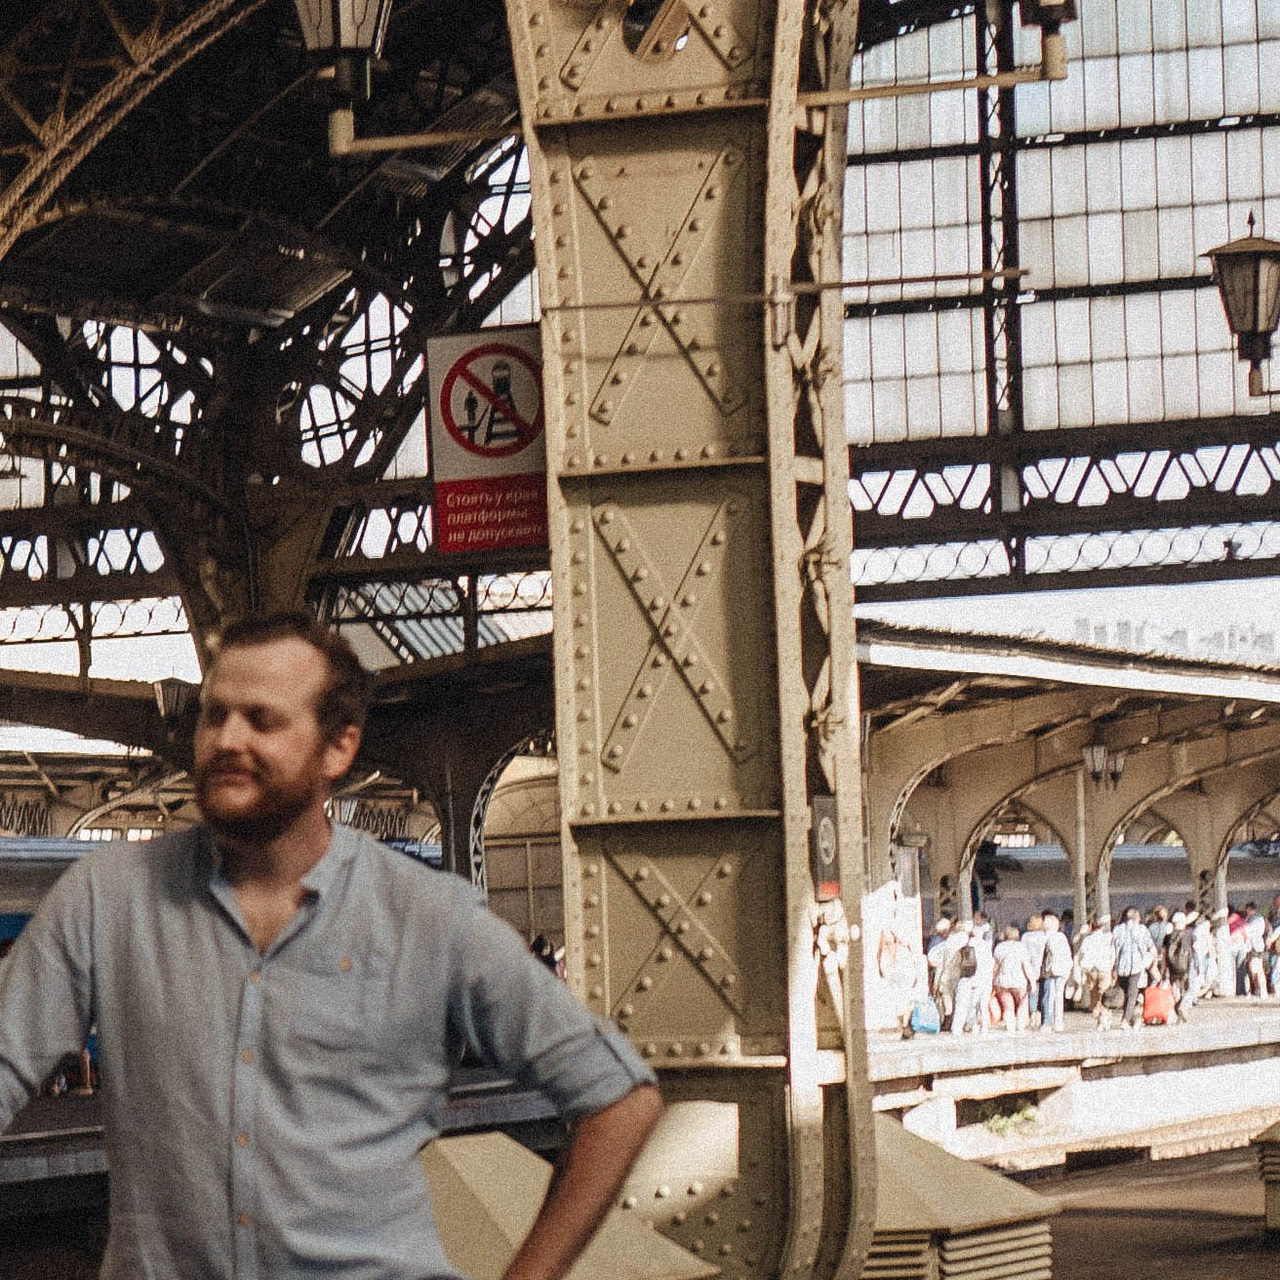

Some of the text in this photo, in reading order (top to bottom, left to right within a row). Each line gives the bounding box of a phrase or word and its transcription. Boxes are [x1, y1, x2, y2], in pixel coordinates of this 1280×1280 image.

[446, 492, 492, 508] Стоять
[495, 492, 503, 507] у
[448, 530, 465, 543] не
